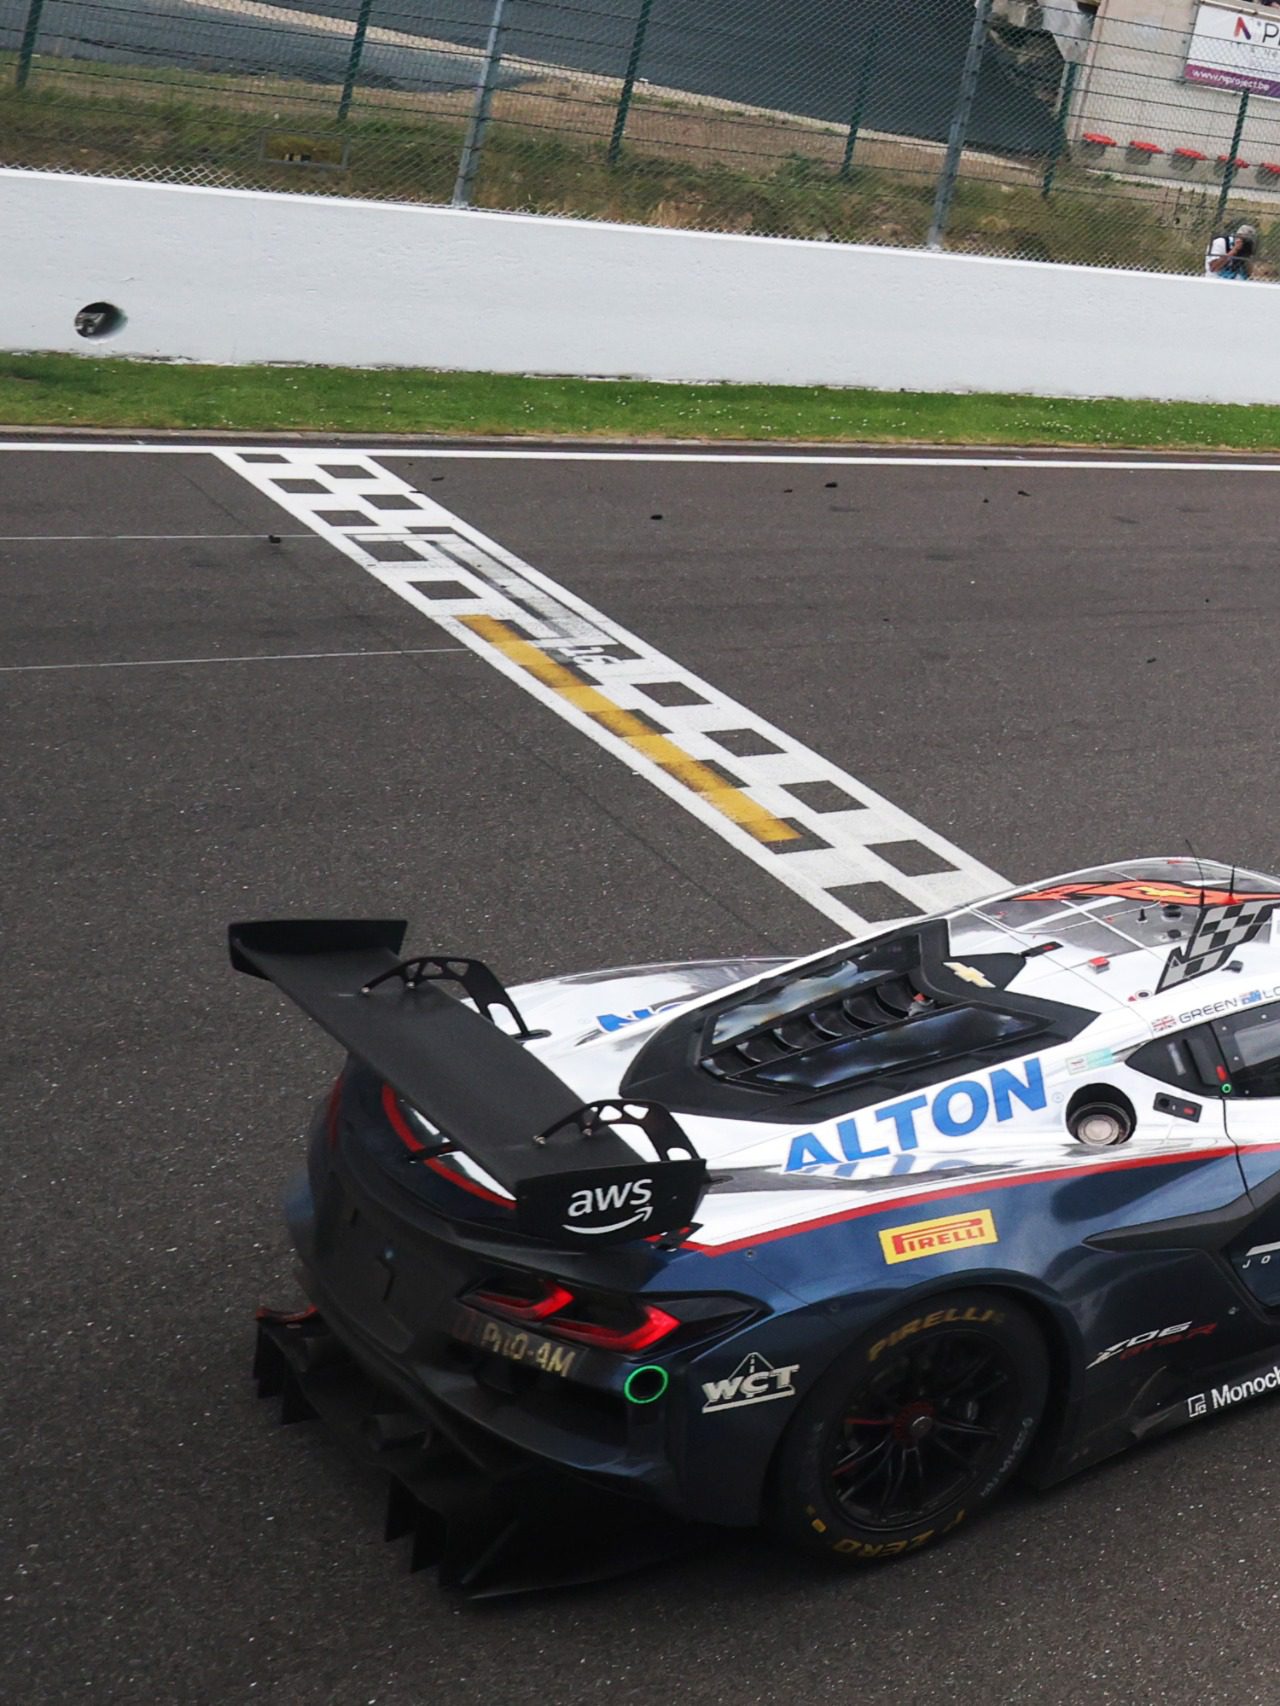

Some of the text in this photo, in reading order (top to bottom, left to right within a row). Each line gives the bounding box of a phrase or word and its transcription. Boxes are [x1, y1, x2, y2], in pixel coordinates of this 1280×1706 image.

[1179, 998, 1239, 1026] GREEN
[785, 1057, 1047, 1173] ALTON
[567, 1177, 653, 1219] aws
[891, 1217, 986, 1255] PIRELLI
[702, 1364, 800, 1403] WCT
